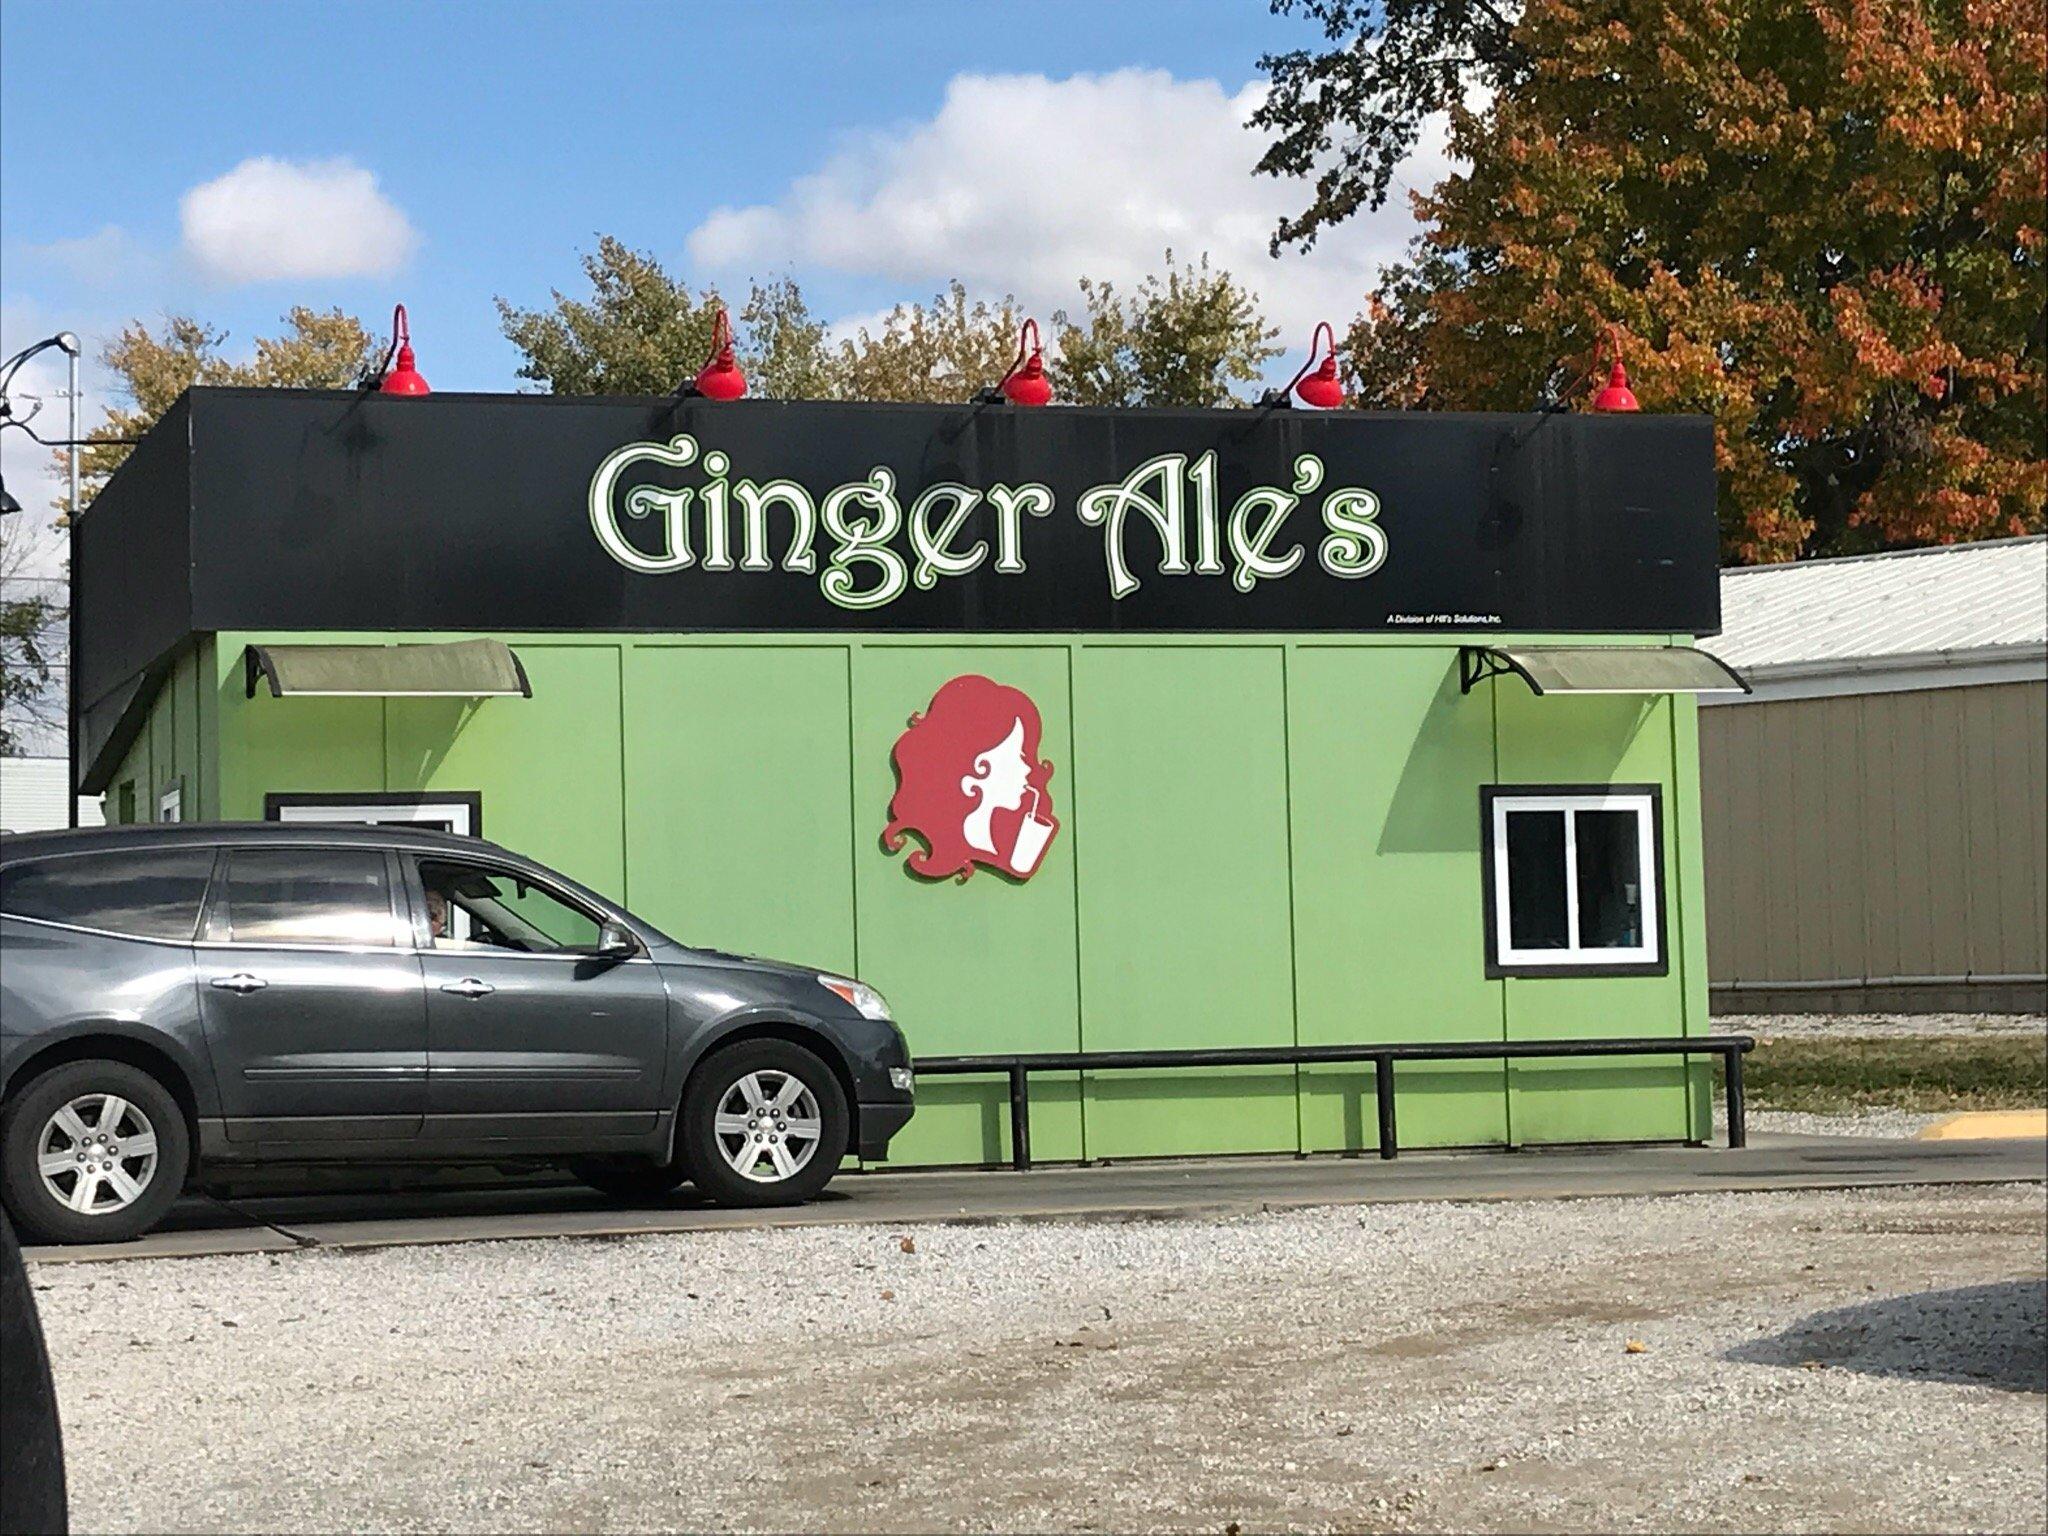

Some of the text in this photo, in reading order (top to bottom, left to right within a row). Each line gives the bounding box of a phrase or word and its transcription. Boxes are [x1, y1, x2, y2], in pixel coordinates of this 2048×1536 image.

[588, 434, 1388, 609] Ginger Ale's
[1386, 614, 1394, 623] A
[1395, 614, 1424, 623] Division
[1425, 614, 1435, 623] of
